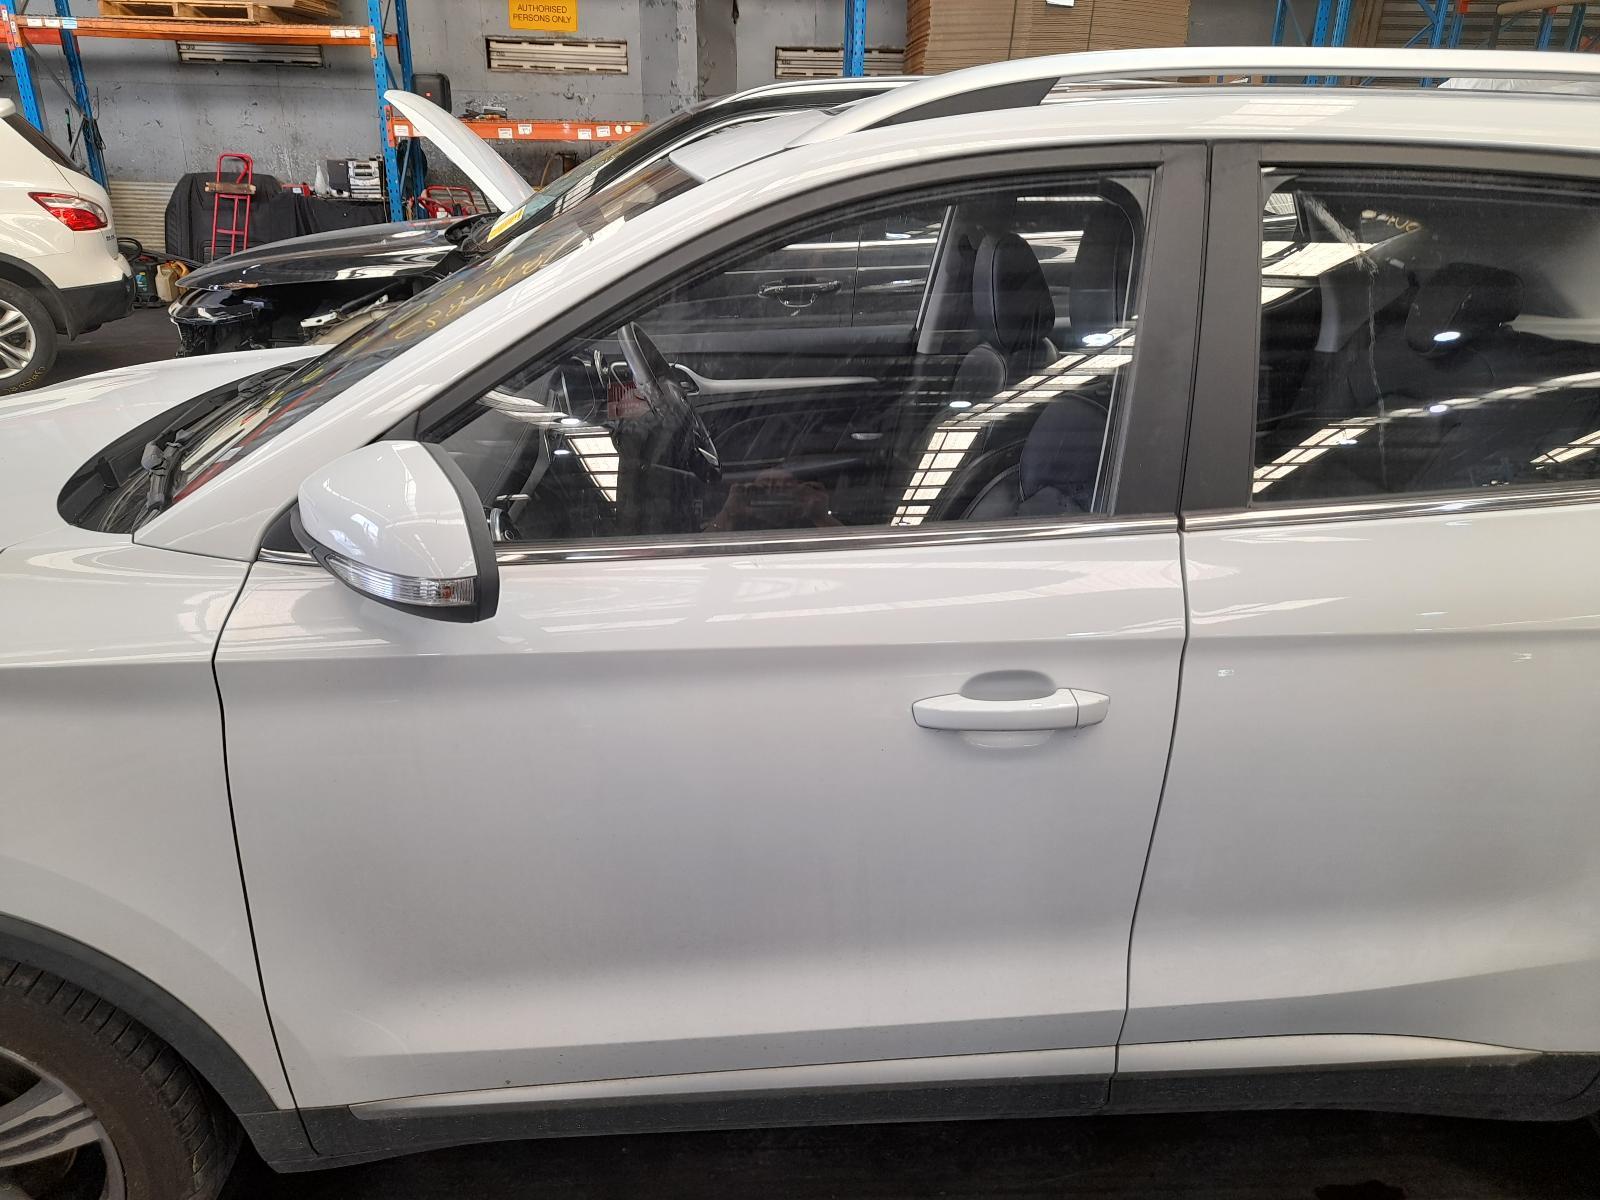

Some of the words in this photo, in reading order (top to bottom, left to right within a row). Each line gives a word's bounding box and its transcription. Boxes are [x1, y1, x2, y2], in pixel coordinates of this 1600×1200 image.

[517, 4, 567, 13] AUTHORISED
[512, 14, 550, 22] PERSONS
[551, 15, 571, 23] ONLY
